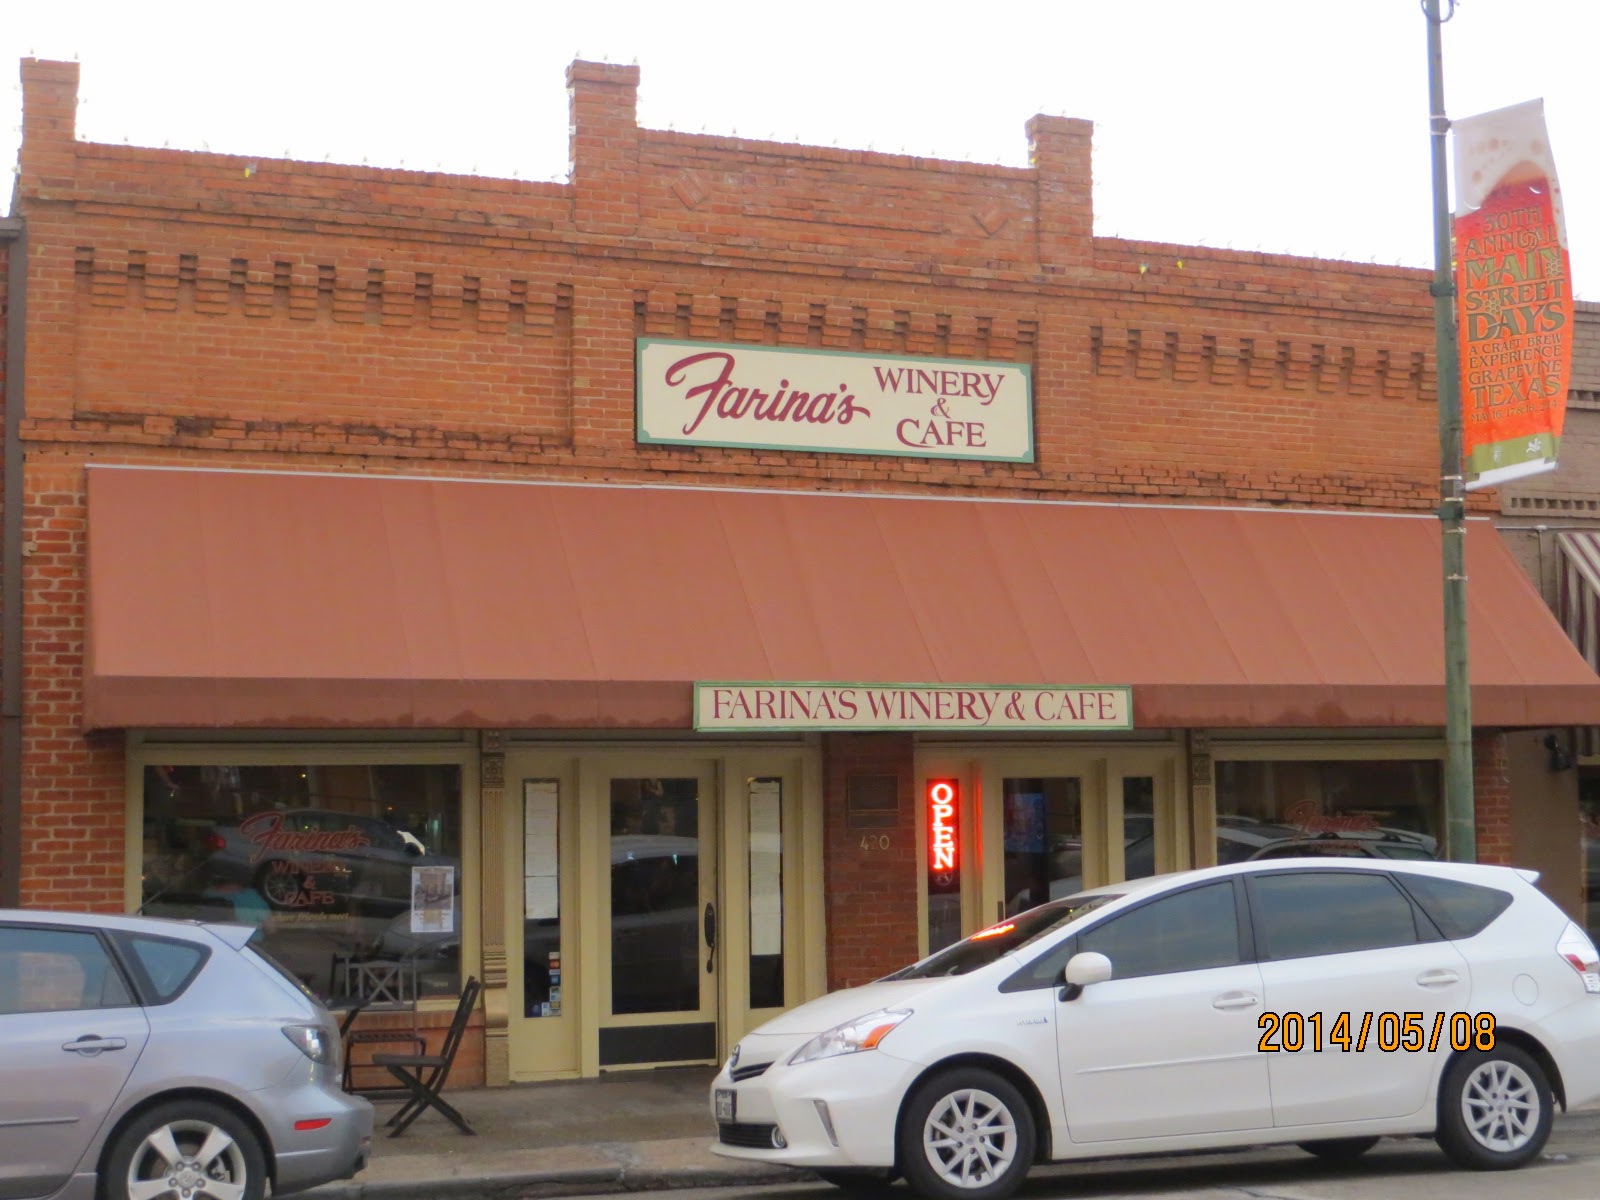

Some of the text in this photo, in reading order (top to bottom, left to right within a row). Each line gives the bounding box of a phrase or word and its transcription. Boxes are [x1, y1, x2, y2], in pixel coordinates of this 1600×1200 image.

[1483, 206, 1543, 233] 30TH
[1465, 224, 1558, 256] ANNUAL
[1464, 245, 1562, 289] MAIN
[1466, 278, 1565, 311] STREET
[1467, 301, 1566, 342] DAYS
[1469, 333, 1562, 355] A CRAFT BREW
[1469, 345, 1562, 369] EXPERIENCE
[872, 366, 1005, 405] WINERY
[1469, 360, 1562, 385] GRAPEVINE
[664, 351, 871, 436] Farina's
[1469, 374, 1562, 409] TEXAS
[929, 397, 953, 419] &
[896, 418, 987, 448] CAFE
[713, 689, 1118, 726] FARINA'S WINERY & CAFE
[859, 834, 890, 850] 420
[931, 783, 955, 869] OPEN
